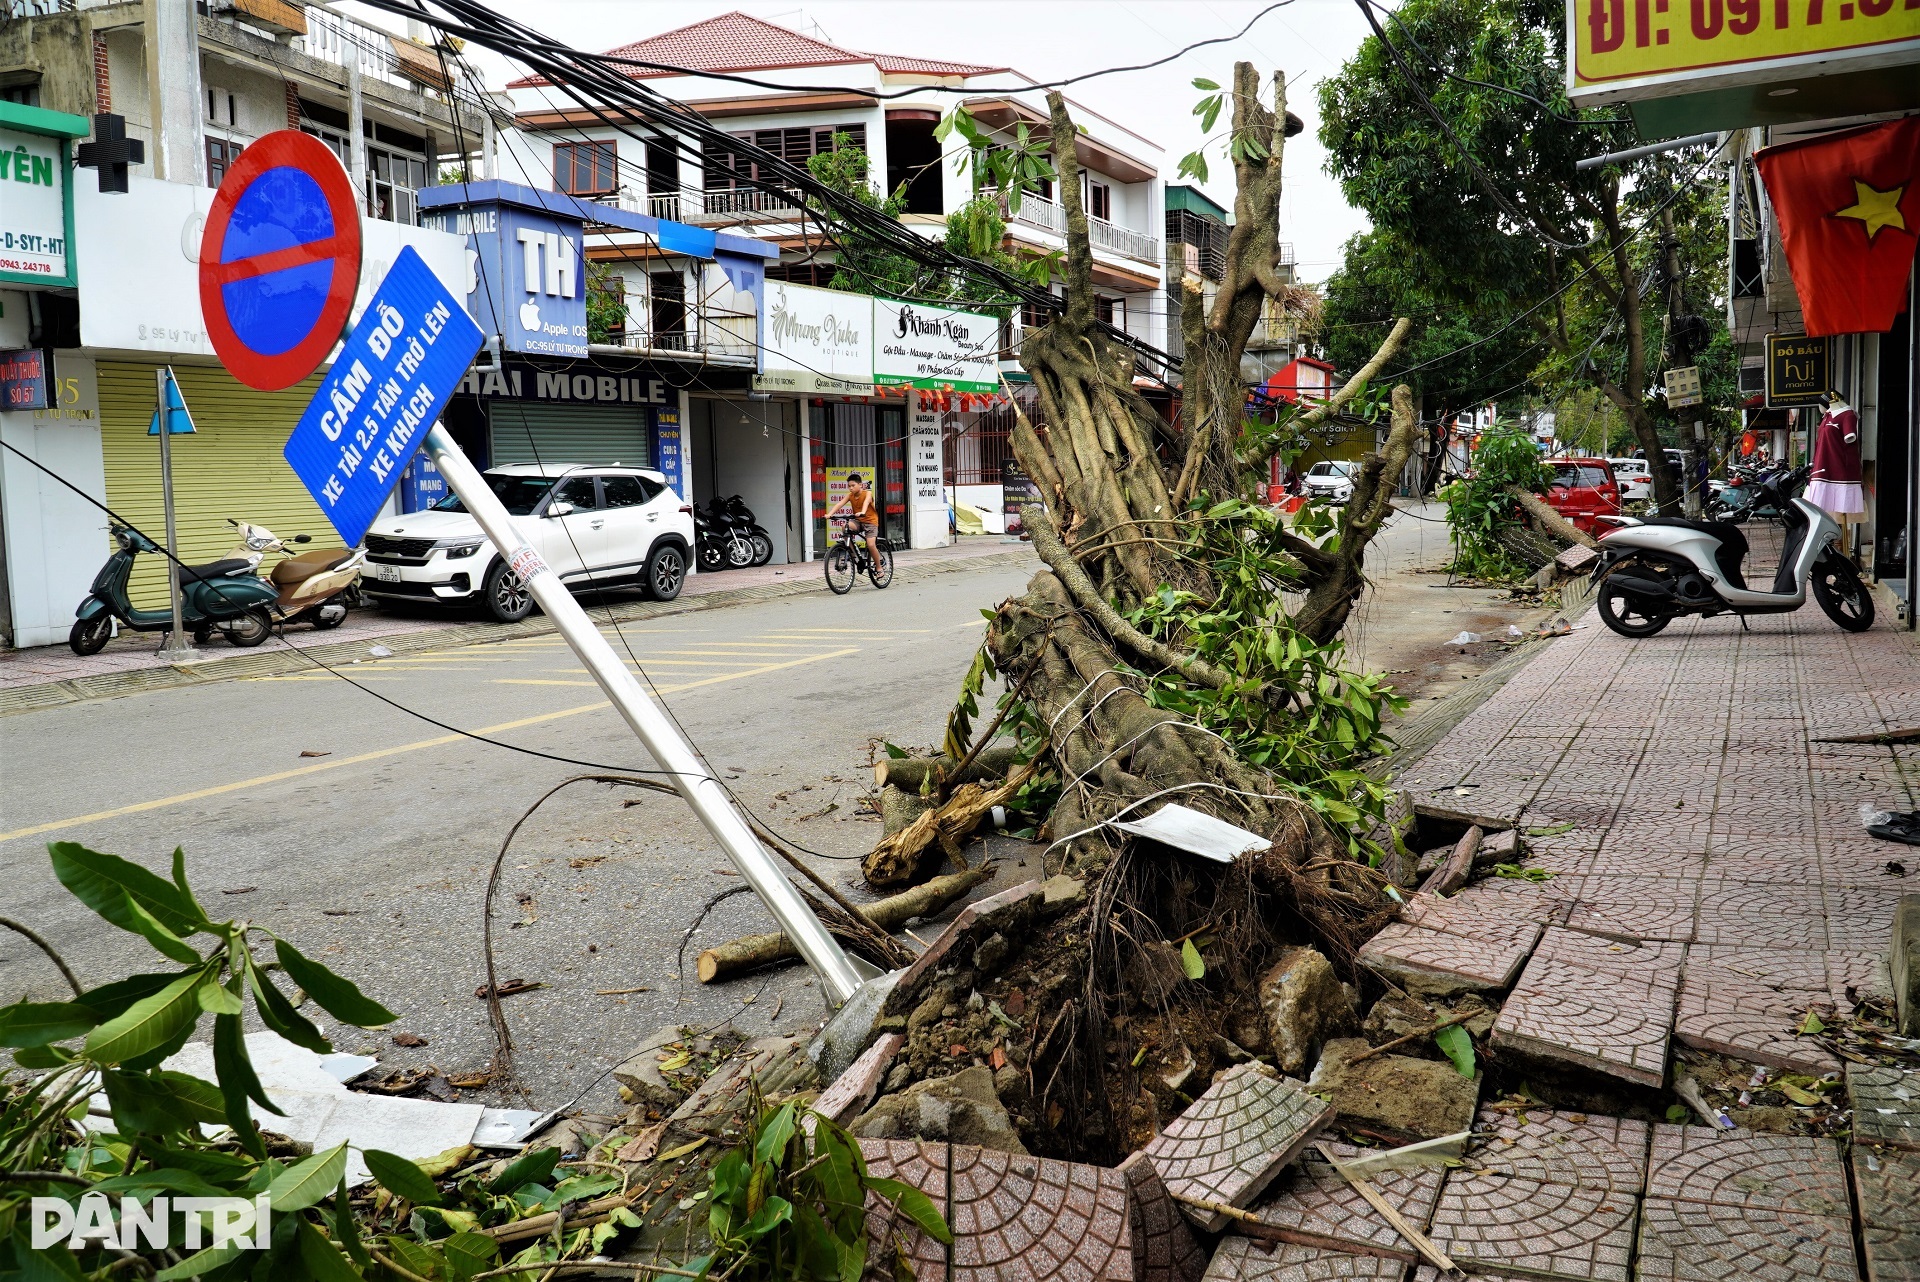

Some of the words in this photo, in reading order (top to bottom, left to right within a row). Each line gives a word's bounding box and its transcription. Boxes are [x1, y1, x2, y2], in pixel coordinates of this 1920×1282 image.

[423, 211, 447, 232] THÁI
[457, 211, 497, 235] MOBILE
[516, 227, 576, 298] TH
[152, 327, 165, 339] 95
[169, 328, 180, 342] Lý
[184, 330, 198, 344] Tự
[543, 321, 569, 337] Apple
[572, 325, 588, 337] IOS
[777, 311, 821, 347] Nhung
[824, 313, 859, 347] Xuka
[909, 315, 942, 337] Khánh
[943, 319, 969, 342] Ngân
[548, 339, 556, 352] LÝ
[565, 344, 588, 356] TRỌNG
[822, 348, 859, 358] BOUTIQUE
[909, 348, 934, 360] Massage
[937, 350, 953, 361] Chăm
[958, 340, 974, 351] Beauty
[974, 342, 984, 352] Spa
[1777, 344, 1794, 357] ĐỒ
[320, 378, 373, 442] CẤM
[366, 299, 405, 361] ĐỖ
[917, 363, 927, 374] Mỹ
[953, 367, 965, 378] Cấp
[10, 382, 22, 403] SỐ
[24, 387, 35, 402] 57
[536, 372, 666, 403] MOBILE
[322, 474, 345, 507] XE
[338, 445, 363, 479] TẢI
[356, 414, 379, 452] 2.5
[372, 376, 402, 420] TẤN
[395, 336, 426, 382] TRỞ
[419, 299, 451, 346] LÊN
[369, 447, 395, 484] XE
[385, 382, 435, 457] KHÁCH
[1329, 425, 1356, 433] Salon
[663, 445, 677, 455] CUNG
[420, 480, 442, 493] MẠNG
